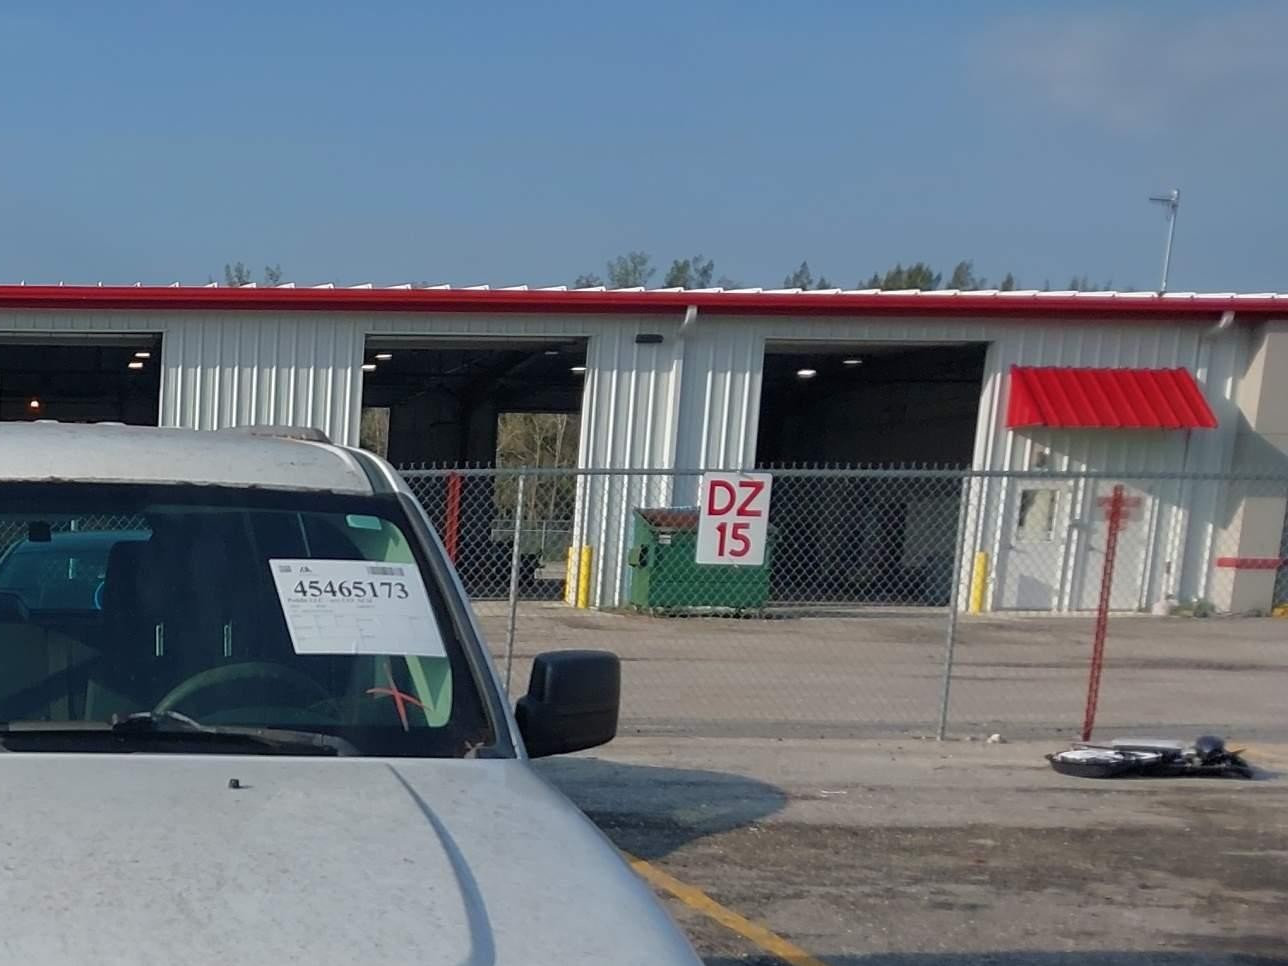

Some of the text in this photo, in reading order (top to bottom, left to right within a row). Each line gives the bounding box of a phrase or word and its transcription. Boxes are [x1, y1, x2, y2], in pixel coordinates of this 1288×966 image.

[708, 480, 765, 517] DZ
[715, 521, 752, 557] 15
[293, 580, 410, 600] 45465173
